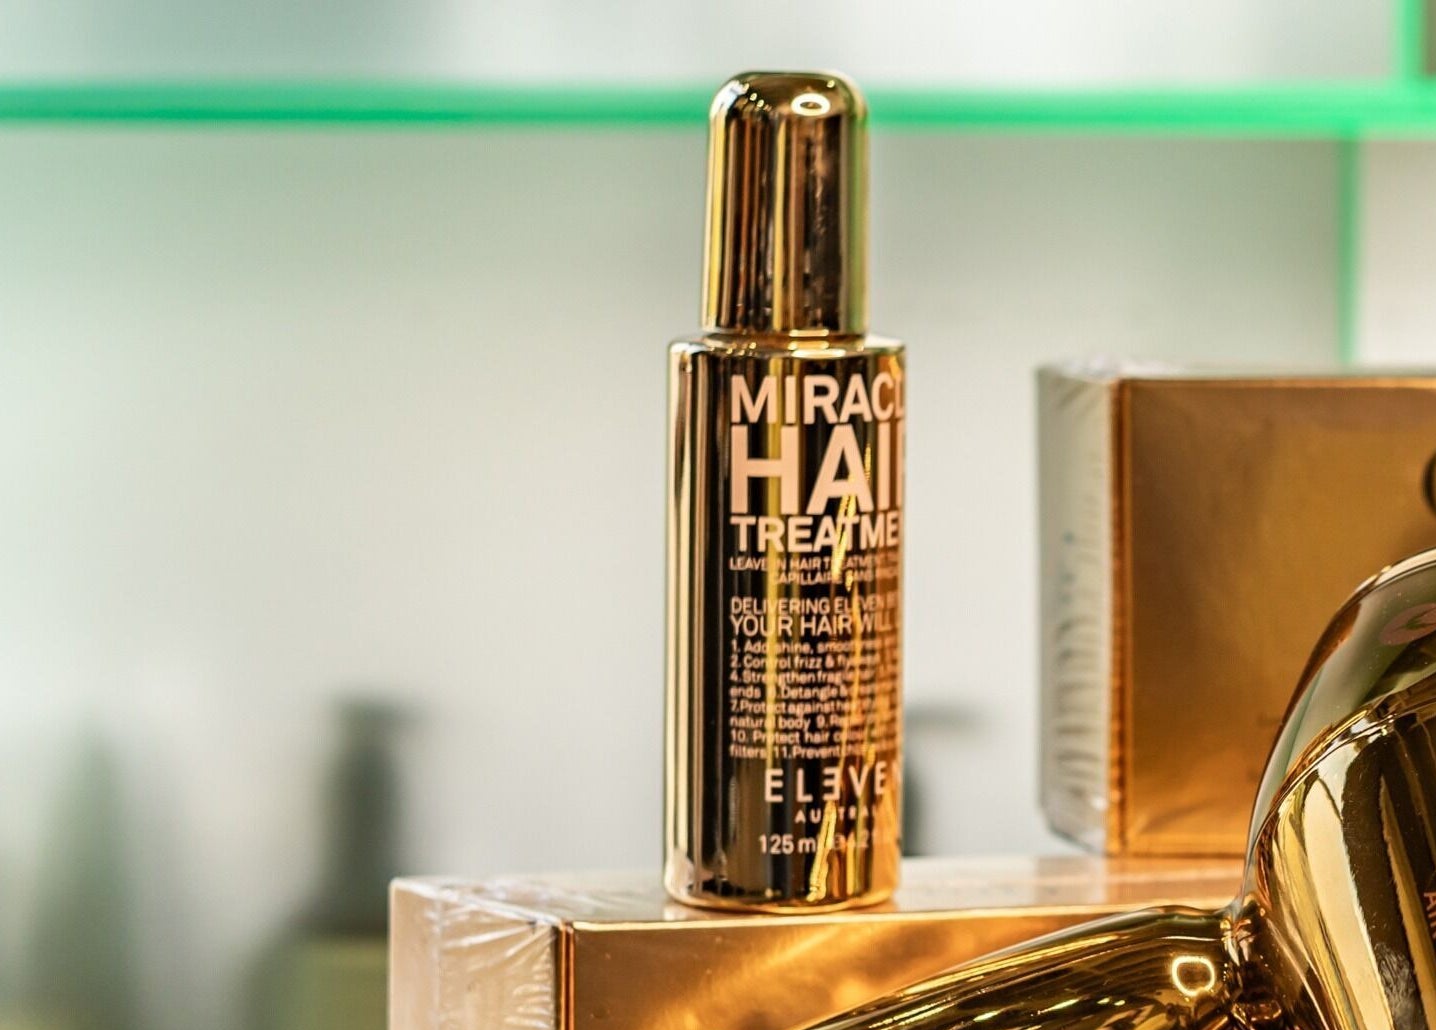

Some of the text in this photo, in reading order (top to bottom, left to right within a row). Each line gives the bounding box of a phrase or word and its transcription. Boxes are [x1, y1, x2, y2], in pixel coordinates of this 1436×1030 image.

[730, 422, 904, 515] HAI
[731, 596, 831, 615] DELIVERING
[834, 595, 885, 614] ELVEN
[729, 614, 794, 637] YOUR
[800, 615, 853, 637] HAIR
[743, 655, 791, 669] Conrol
[794, 656, 823, 669] frizz
[742, 671, 815, 687] Stregthen
[778, 715, 811, 733] body
[752, 730, 801, 745] Prtect
[759, 832, 795, 856] 125
